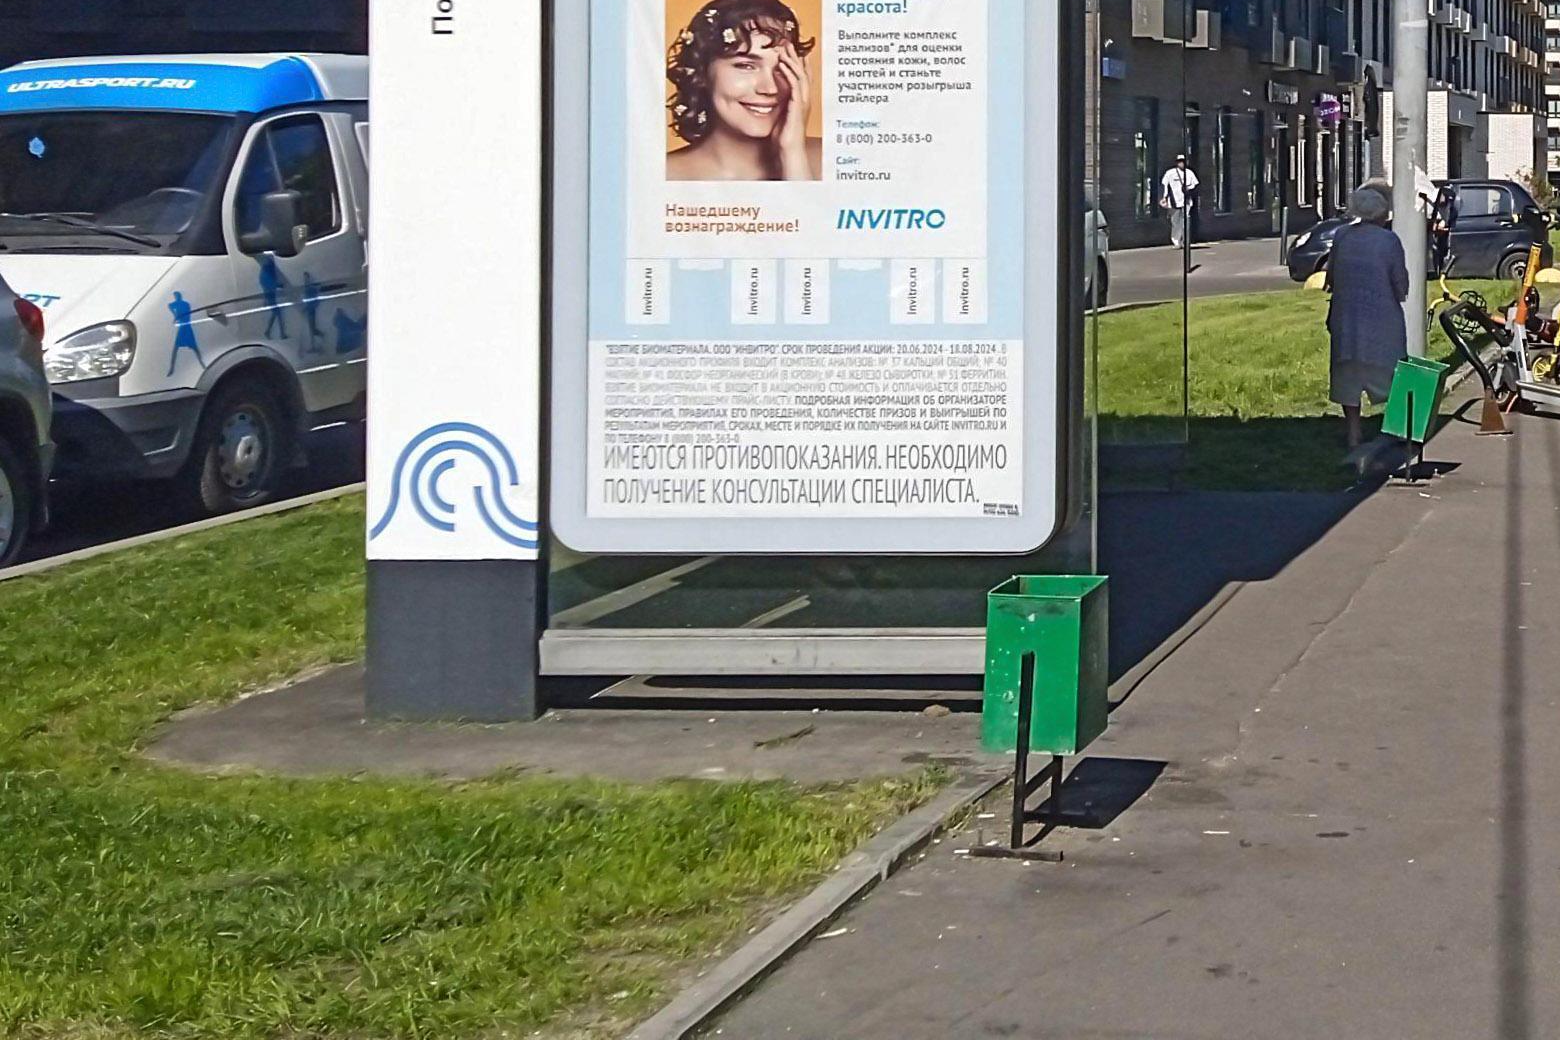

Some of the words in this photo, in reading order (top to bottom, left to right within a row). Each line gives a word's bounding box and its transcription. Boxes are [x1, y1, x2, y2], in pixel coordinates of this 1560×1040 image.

[836, 0, 908, 17] красота!
[838, 29, 901, 41] Выполните
[903, 31, 958, 41] комплекс
[897, 44, 919, 54] для
[921, 44, 963, 54] оценки
[838, 56, 896, 66] состояния
[898, 56, 931, 67] кожи,
[933, 56, 967, 66] волос
[838, 69, 846, 78] и
[848, 67, 886, 78] ногтей
[889, 69, 897, 78] и
[898, 69, 942, 78] станьте
[7, 77, 197, 93] ULTRASPORT.RU
[837, 81, 904, 93] участником
[906, 81, 972, 92] розыгрыша
[838, 93, 889, 105] стайлера
[876, 133, 933, 144] 200-363-0
[836, 169, 892, 181] invitro.ru
[665, 203, 761, 220] Нашедшему
[836, 208, 946, 230] INVITRO
[665, 219, 800, 236] вознаграждение!
[642, 267, 653, 316] invitro.ru
[747, 267, 759, 316] invitro.ru
[801, 267, 812, 316] invitro.ru
[906, 267, 918, 316] invitro.ru
[958, 267, 970, 316] invitro.ru
[782, 344, 804, 354] СРОК
[806, 344, 861, 354] ПРОВЕДЕНИЯ
[794, 395, 851, 405] ПОДРОБНАЯ
[853, 395, 920, 405] ИНФОРМАЦИЯ
[923, 395, 935, 405] ОБ
[938, 395, 1007, 405] ОРГАНИЗАТОРЕ
[731, 408, 747, 418] ЕГО
[817, 408, 876, 418] КОЛИЧЕСТВЕ
[879, 408, 917, 418] ПРИЗОВ
[919, 408, 927, 418] И
[930, 406, 990, 418] ВЫИГРЫШЕЙ
[993, 408, 1007, 418] ПО
[765, 421, 793, 431] МЕСТЕ
[844, 421, 856, 431] ИХ
[910, 421, 922, 431] НА
[923, 419, 949, 431] САЙТЕ
[1000, 421, 1007, 431] И
[603, 444, 688, 470] ИМЕЮТСЯ
[692, 444, 882, 470] ПРОТИВОПОКАЗАНИЯ.
[885, 444, 1007, 473] НЕОБХОДИМО
[603, 478, 707, 504] ПОЛУЧЕНИЕ
[711, 478, 847, 507] КОНСУЛЬТАЦИИ
[851, 478, 980, 507] СПЕЦИАЛИСТА.
